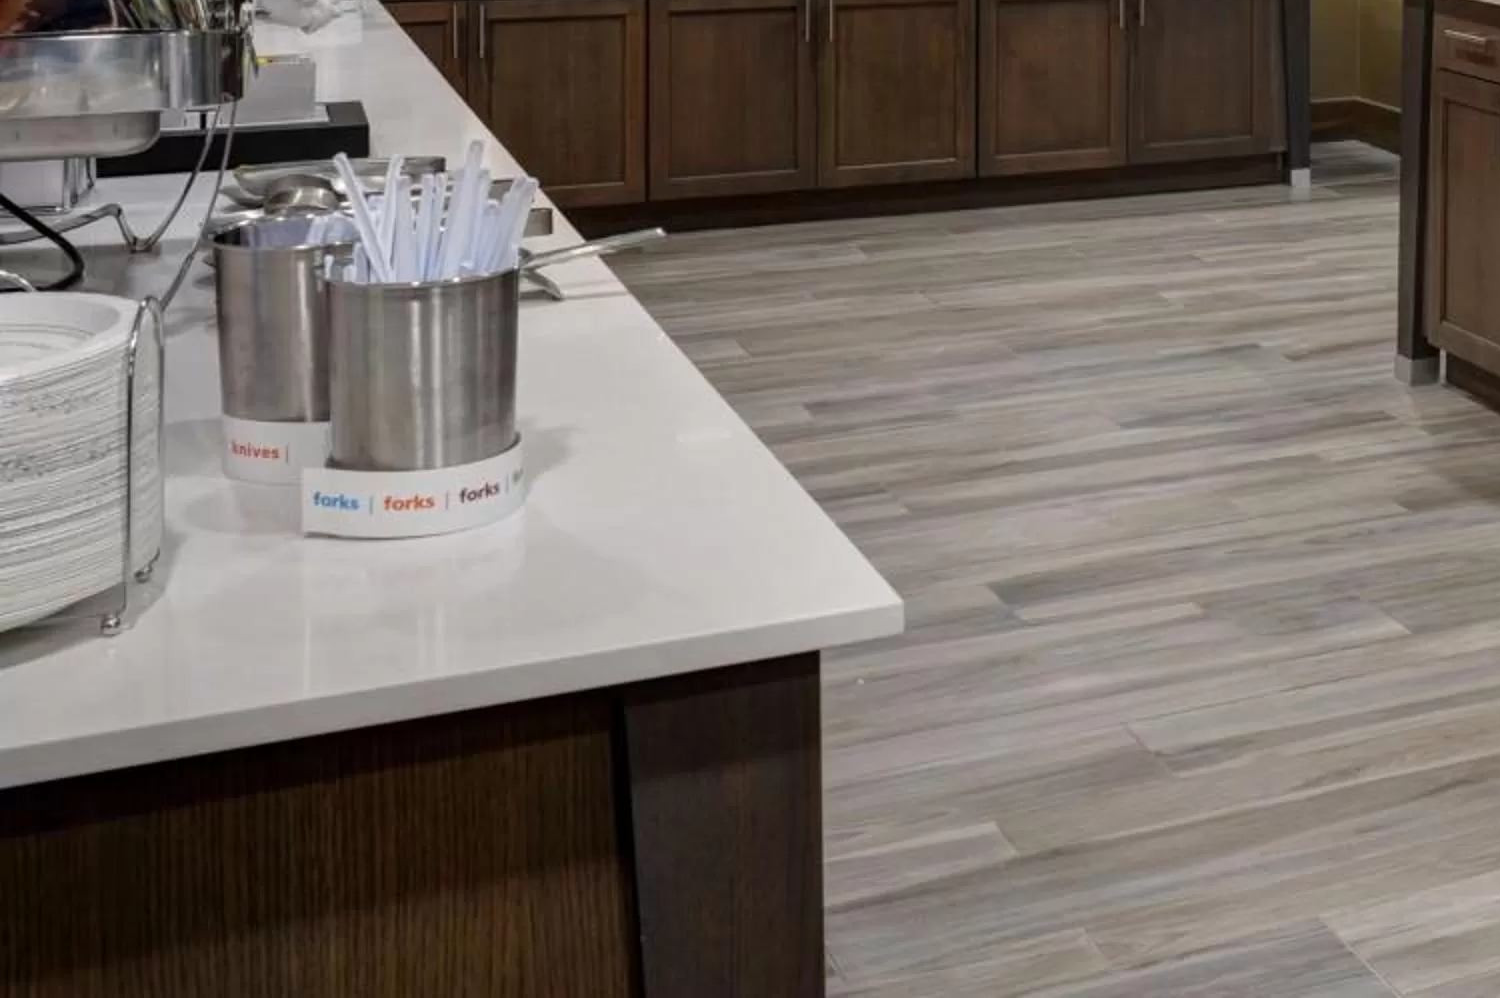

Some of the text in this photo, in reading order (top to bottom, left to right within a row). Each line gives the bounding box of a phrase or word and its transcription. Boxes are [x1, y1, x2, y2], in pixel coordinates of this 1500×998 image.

[231, 440, 280, 459] knives
[313, 482, 500, 511] forks forks forks
